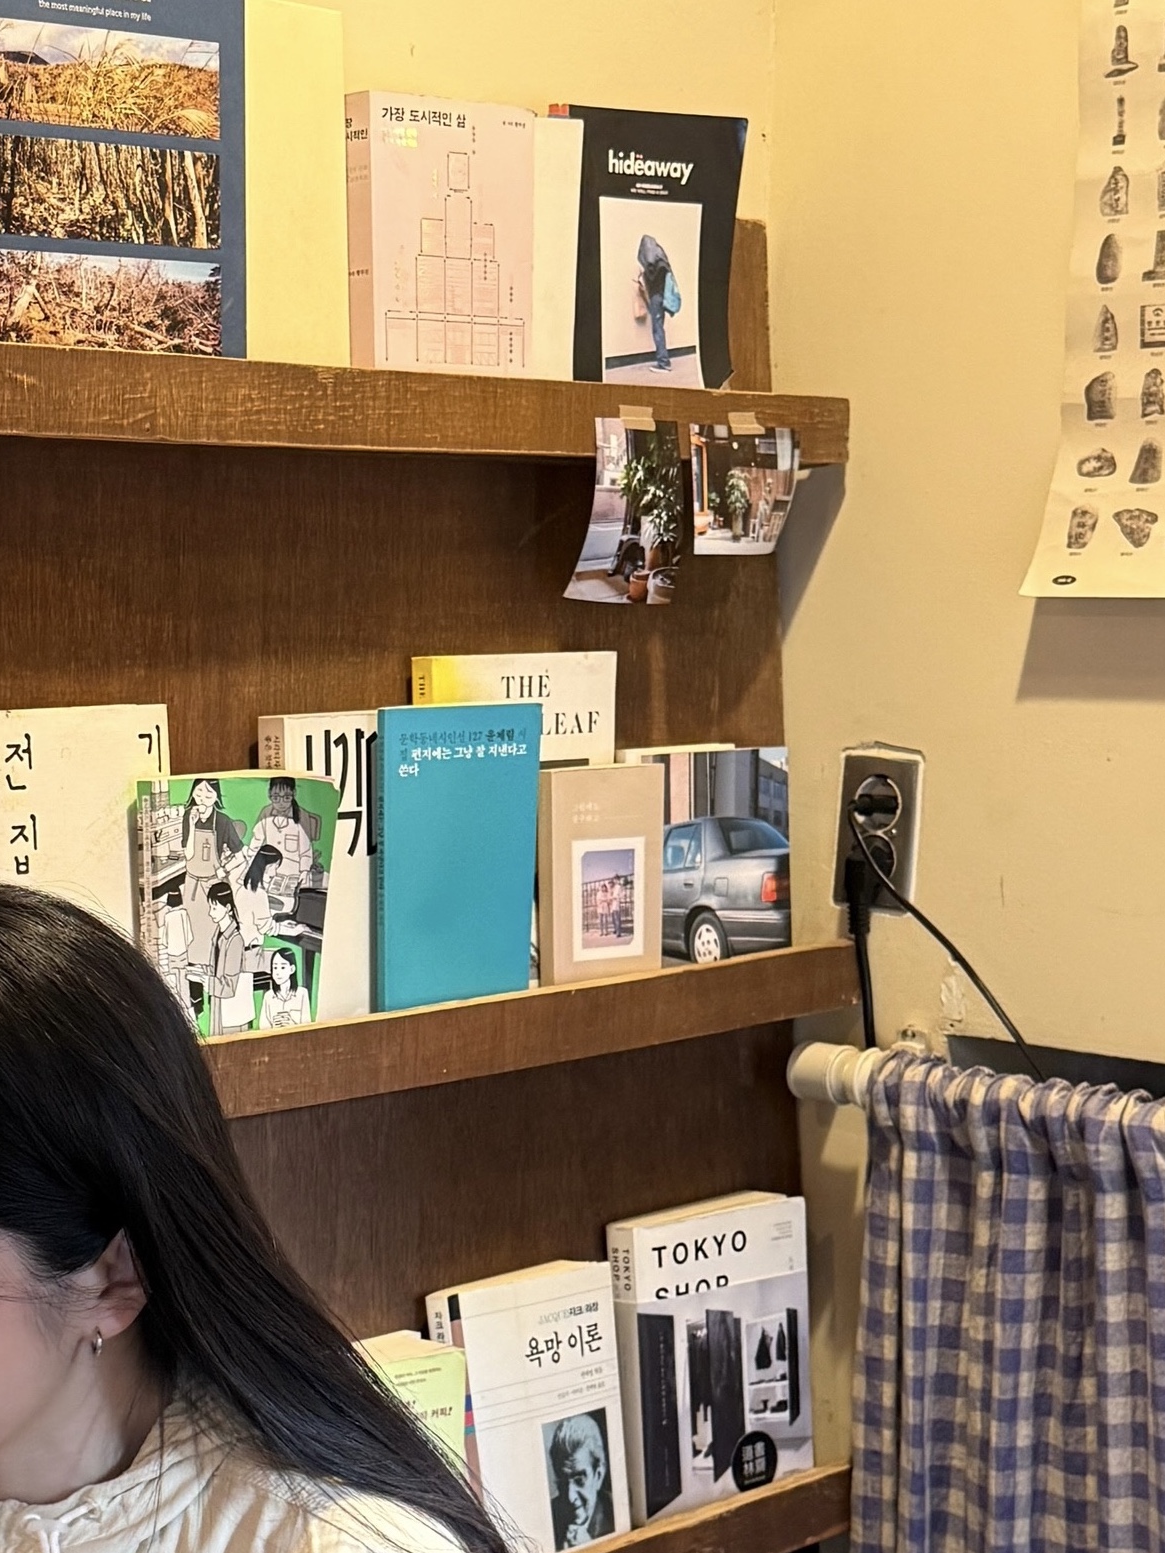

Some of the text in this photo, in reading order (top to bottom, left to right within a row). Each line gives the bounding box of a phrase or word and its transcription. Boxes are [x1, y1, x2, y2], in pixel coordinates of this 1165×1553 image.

[51, 2, 68, 11] most
[69, 4, 104, 16] meaningful
[105, 8, 123, 18] place
[130, 12, 140, 21] my
[141, 12, 152, 21] life
[382, 106, 405, 122] 가장
[409, 109, 452, 127] 도시적인
[501, 676, 551, 699] THE
[468, 731, 482, 742] 127
[453, 745, 473, 759] 그냥
[476, 744, 485, 758] 잘
[488, 743, 528, 757] 지낸다고
[398, 763, 419, 777] 쓴다
[651, 1230, 747, 1268] TOKYO
[611, 1247, 620, 1282] SHOP
[622, 1248, 632, 1291] TOKYO
[525, 1322, 603, 1368] 욕망 이론
